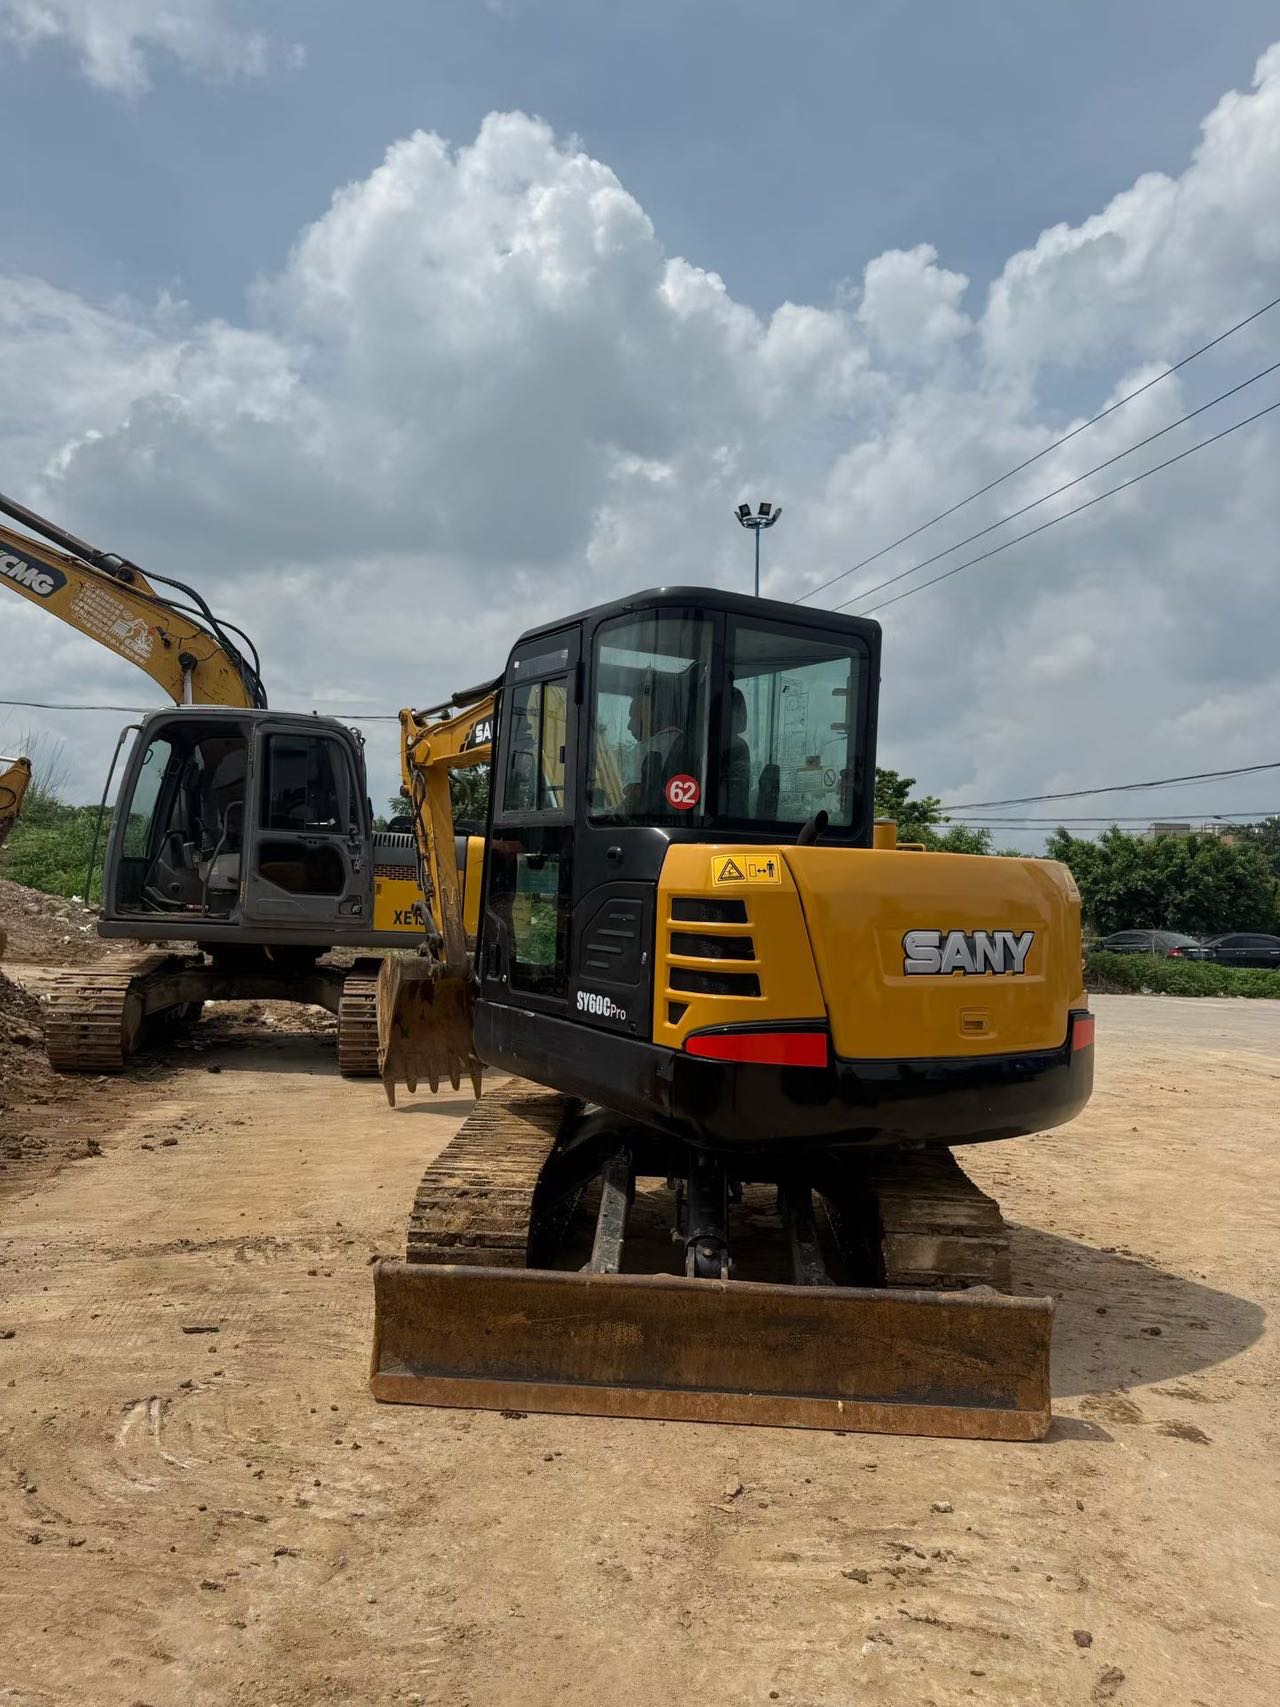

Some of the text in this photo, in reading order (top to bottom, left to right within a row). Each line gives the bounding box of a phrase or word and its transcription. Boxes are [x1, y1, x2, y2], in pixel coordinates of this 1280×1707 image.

[0, 549, 54, 594] CMG
[670, 781, 696, 803] 62
[903, 929, 1035, 975] SANY
